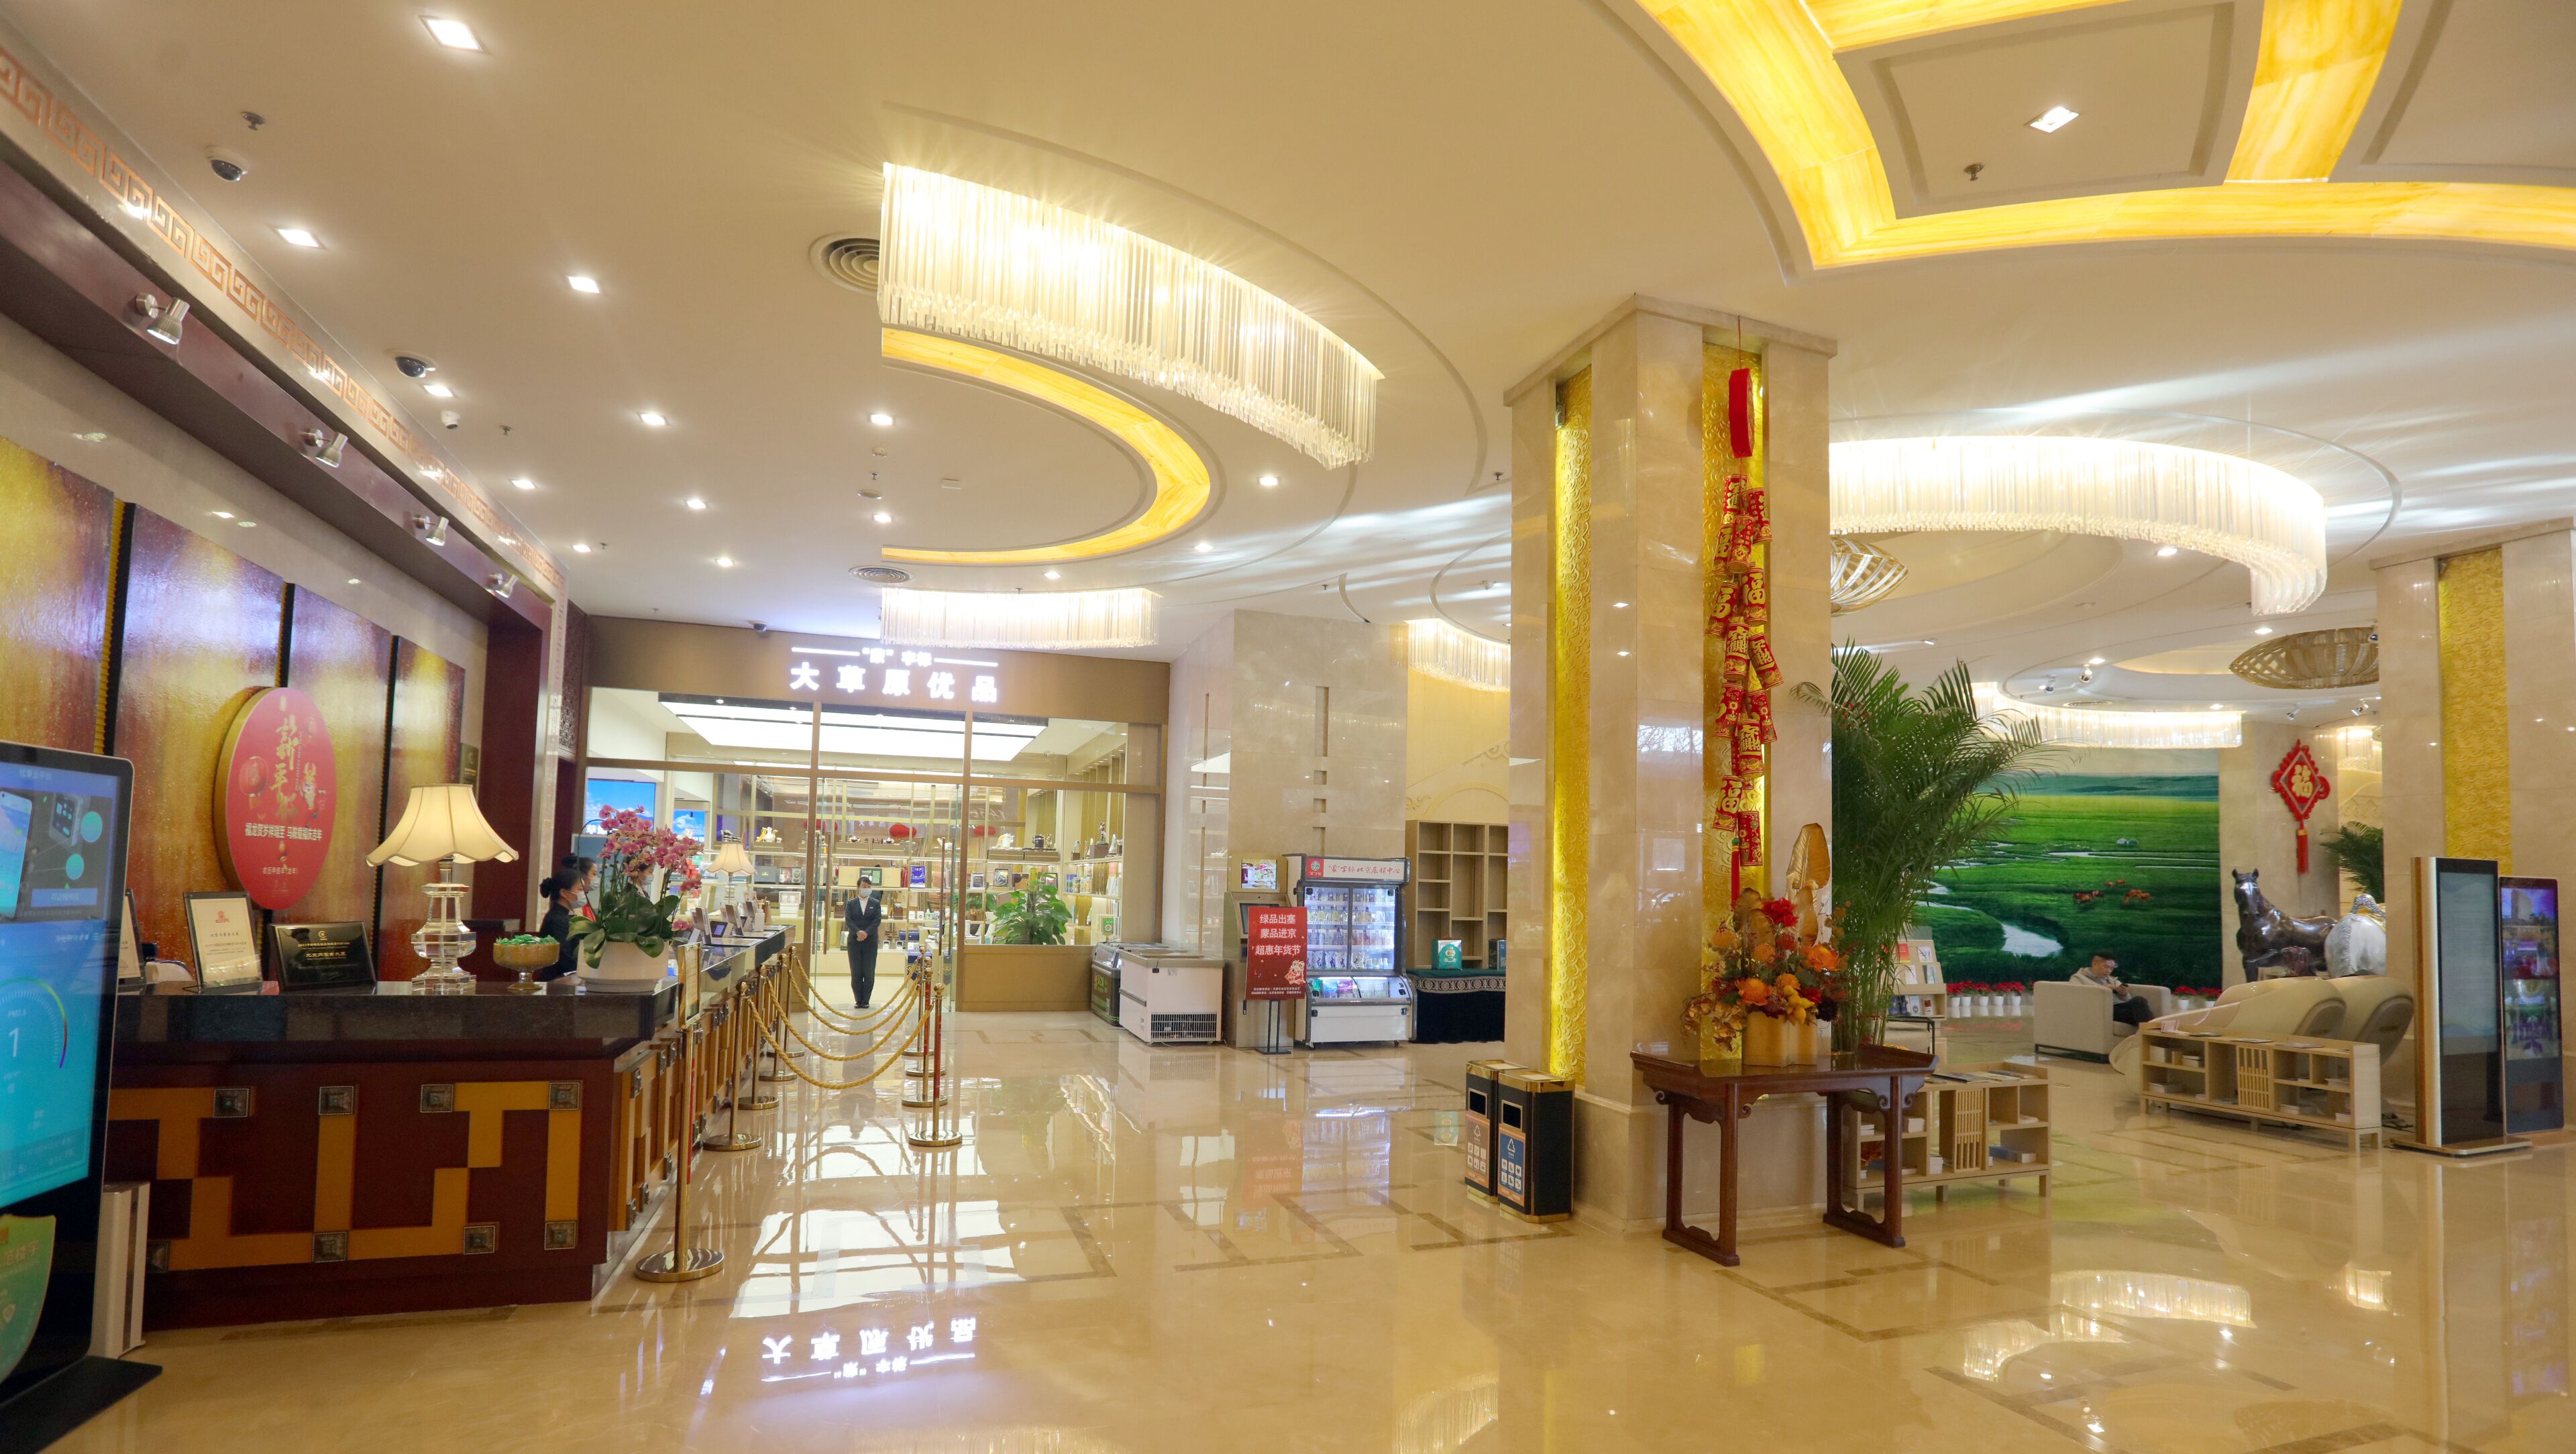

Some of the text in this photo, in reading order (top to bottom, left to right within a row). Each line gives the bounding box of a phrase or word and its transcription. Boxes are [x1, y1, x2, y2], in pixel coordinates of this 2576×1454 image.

[790, 661, 998, 703] 大草原优品
[2292, 764, 2313, 798] 福
[1260, 913, 1296, 924] 绿品出塞
[1260, 928, 1297, 939] 蒙品进京
[1255, 944, 1301, 955] 超惠年货节
[9, 1027, 19, 1058] 1
